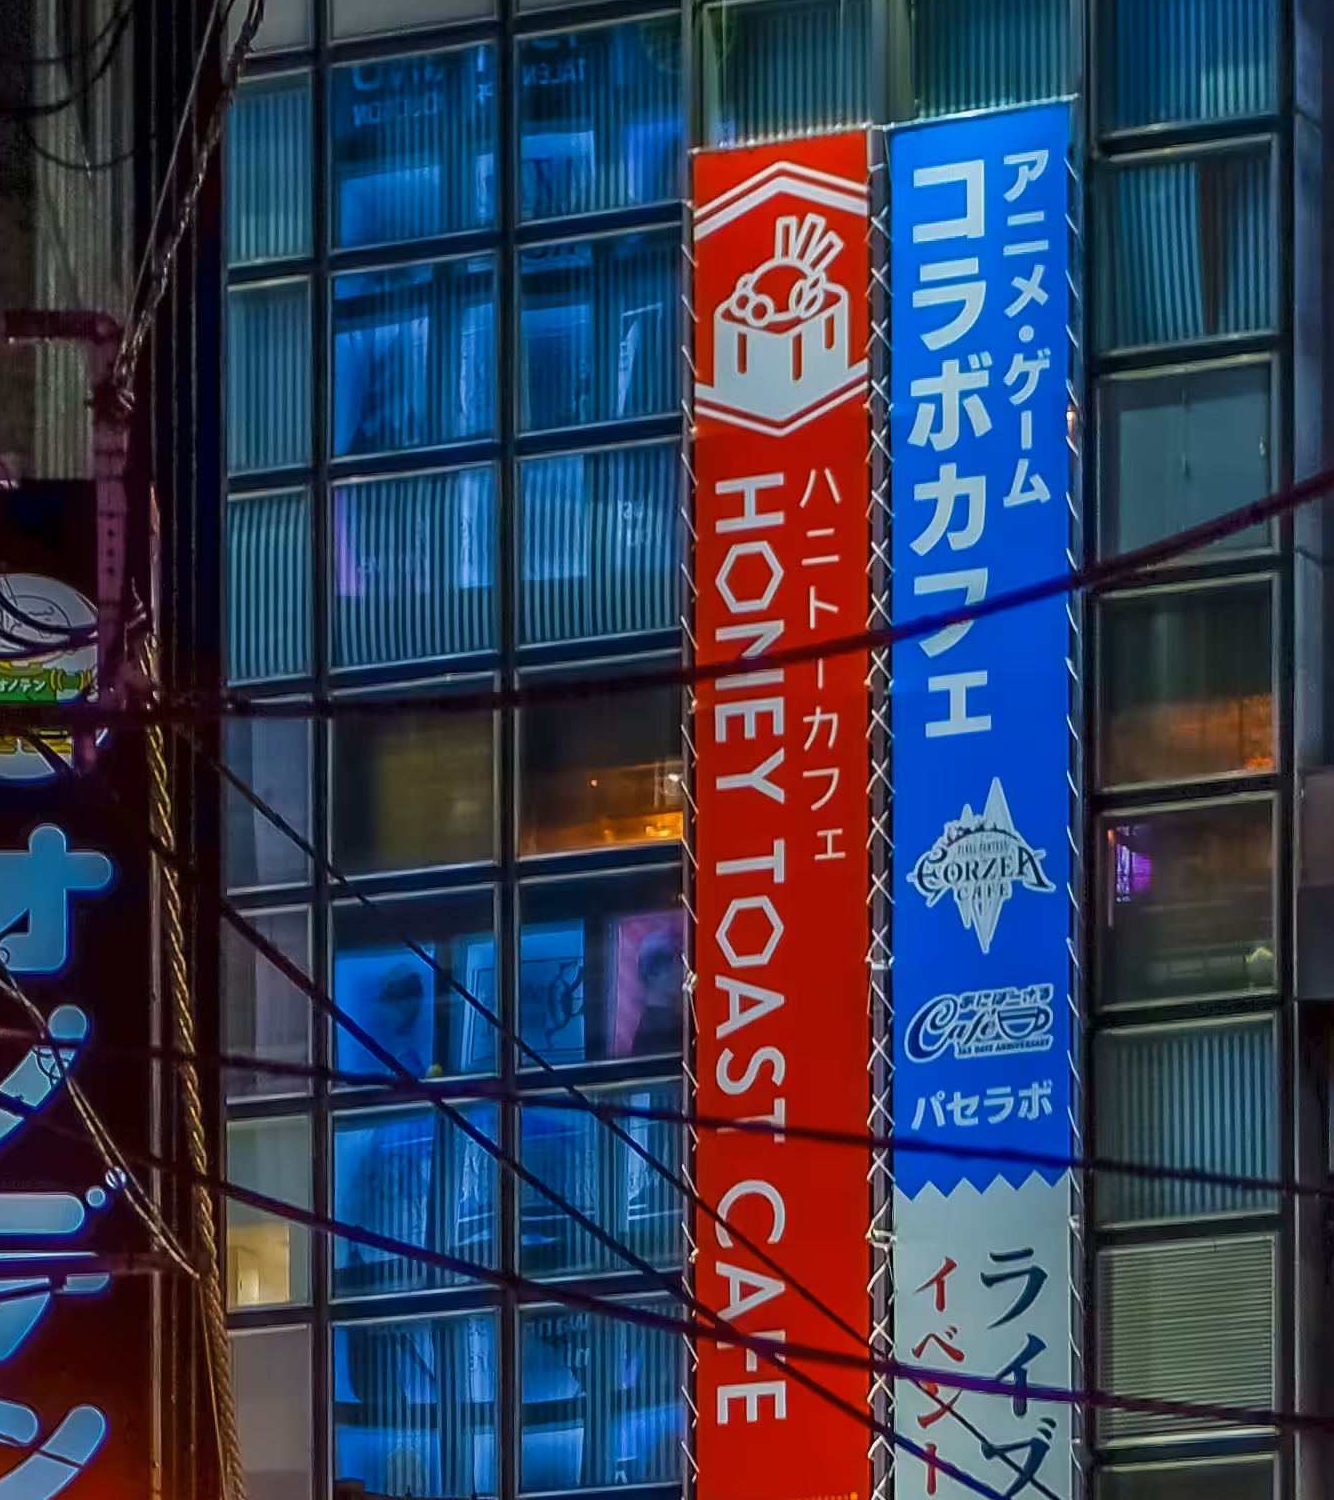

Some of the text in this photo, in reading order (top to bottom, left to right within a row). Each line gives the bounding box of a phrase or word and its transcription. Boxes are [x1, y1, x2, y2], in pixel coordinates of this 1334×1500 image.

[907, 158, 996, 739] コラボカフェ
[1003, 148, 1052, 508] アニメ・ゲーム
[715, 471, 786, 805] HONEY
[715, 838, 787, 1143] TOAST
[911, 1080, 1054, 1131] パセラボ
